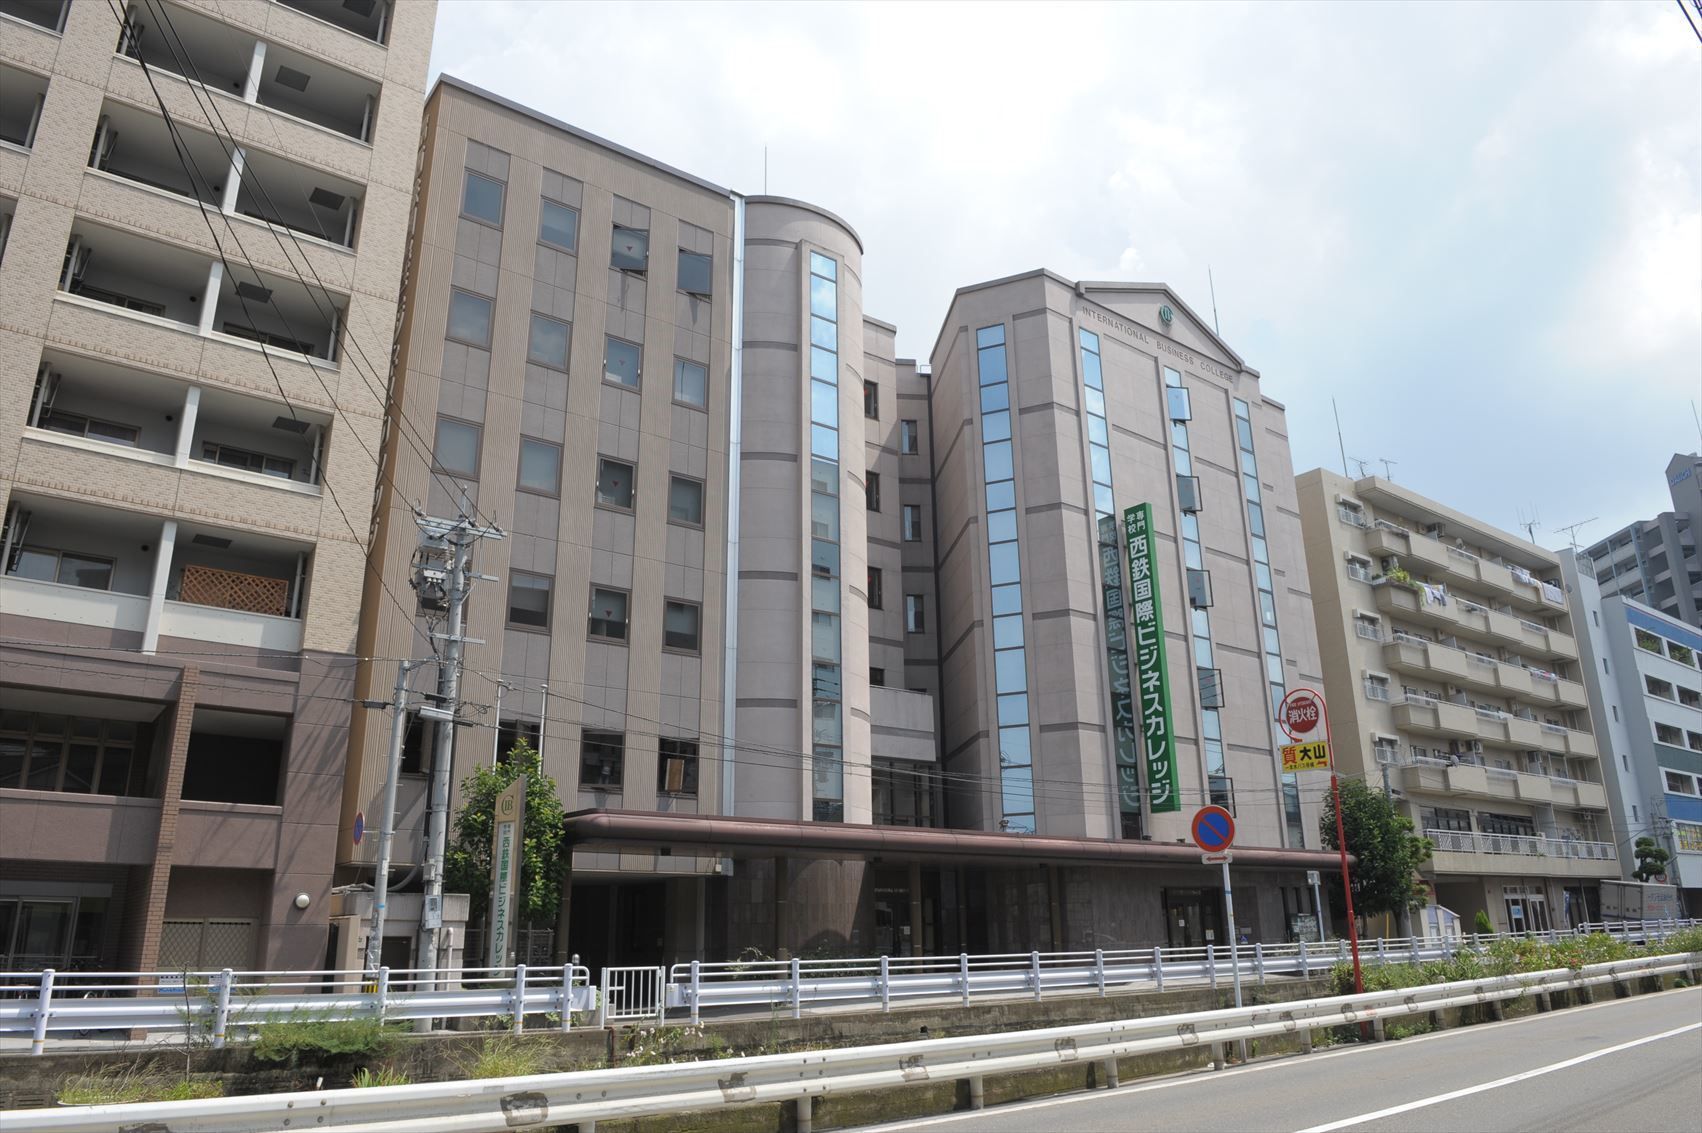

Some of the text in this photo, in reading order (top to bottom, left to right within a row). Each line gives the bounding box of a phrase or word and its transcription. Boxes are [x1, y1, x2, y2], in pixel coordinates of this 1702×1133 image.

[1082, 306, 1149, 344] INTERNATIONAL
[1156, 340, 1194, 365] BUSINESS
[1200, 362, 1233, 382] COLLEGE
[1129, 534, 1171, 805] 西鉄国際ビジネスカレッジ
[1289, 706, 1318, 724] 消火栓
